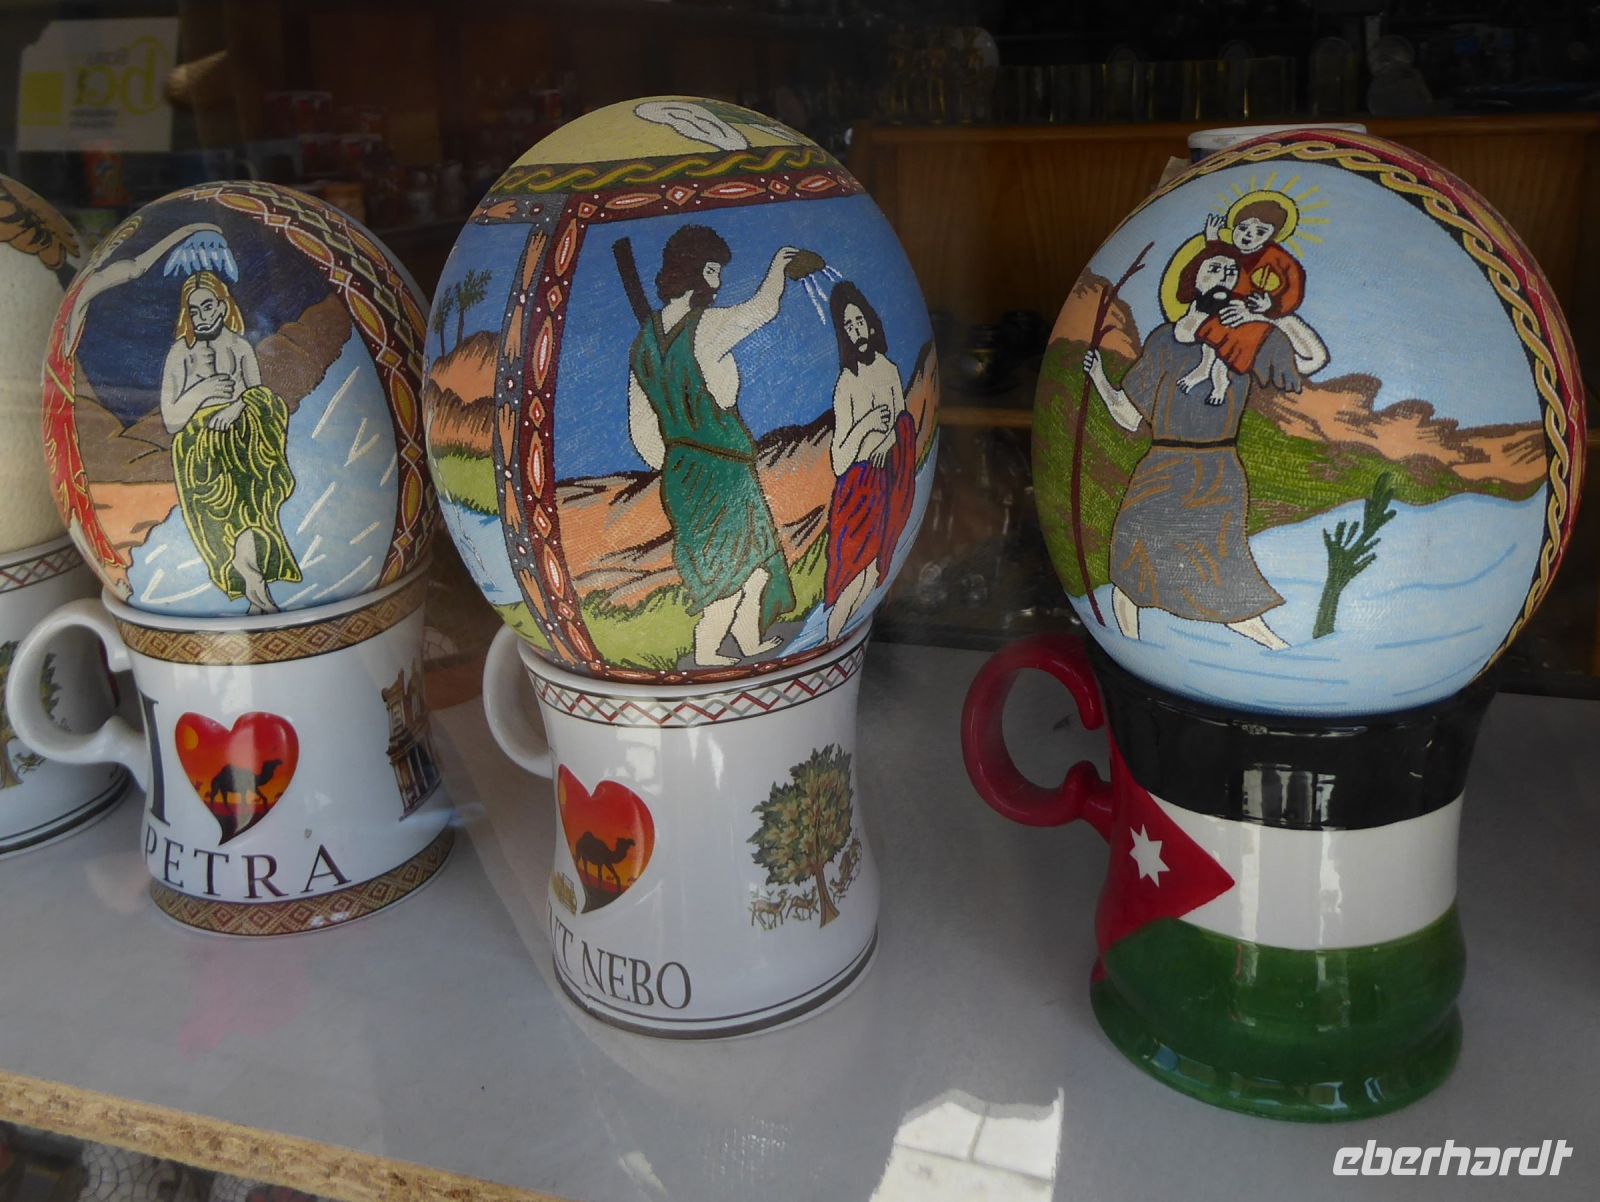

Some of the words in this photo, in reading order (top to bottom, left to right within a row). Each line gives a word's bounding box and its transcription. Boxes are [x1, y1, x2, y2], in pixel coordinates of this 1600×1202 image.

[138, 689, 170, 827] I
[145, 823, 352, 899] PETRA
[581, 940, 692, 1010] NEBO
